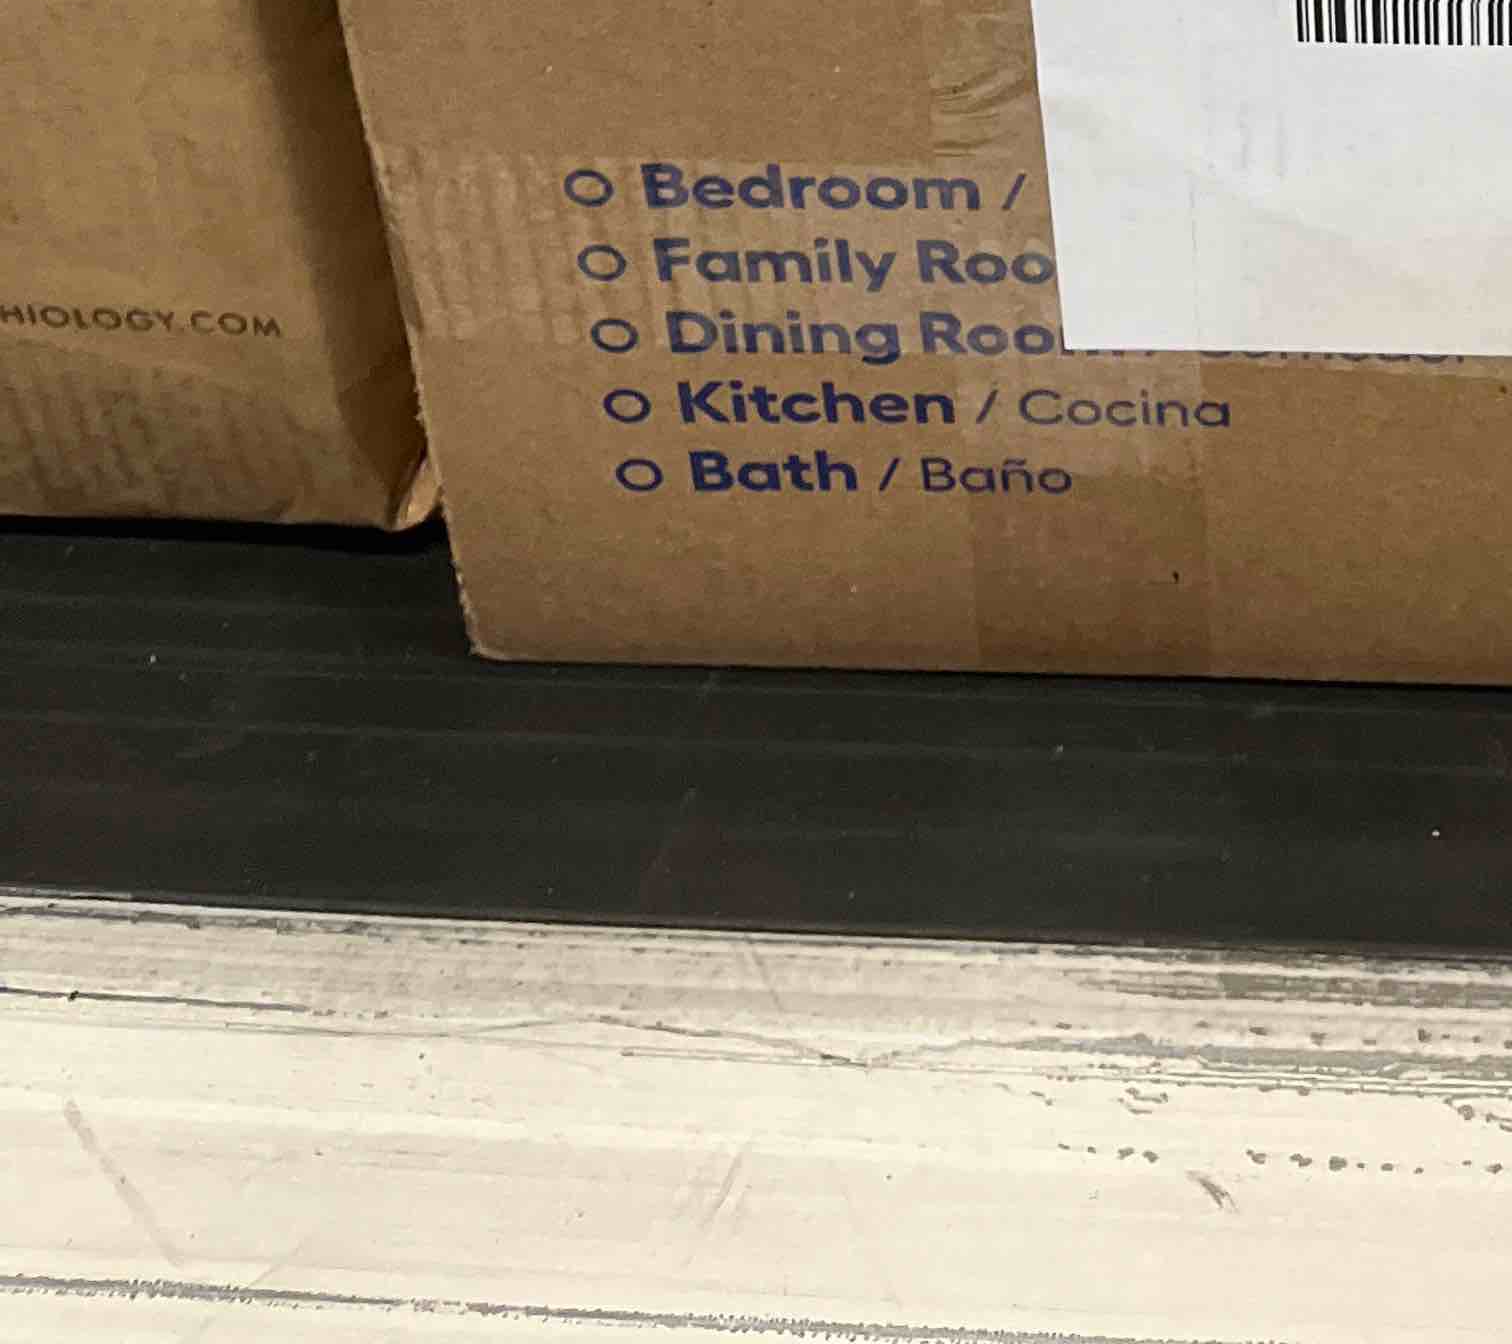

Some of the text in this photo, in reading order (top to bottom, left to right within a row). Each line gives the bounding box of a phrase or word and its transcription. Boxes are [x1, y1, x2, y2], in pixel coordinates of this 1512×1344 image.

[641, 163, 981, 212] Bedroom
[653, 237, 1056, 293] Family Roo
[0, 302, 282, 338] HIOLOGY.COM
[666, 309, 1056, 365] Dining Roo
[676, 379, 956, 425] Kitchen
[1018, 387, 1232, 428] Cocina
[688, 450, 859, 494] Bath
[921, 457, 1074, 496] Baño
